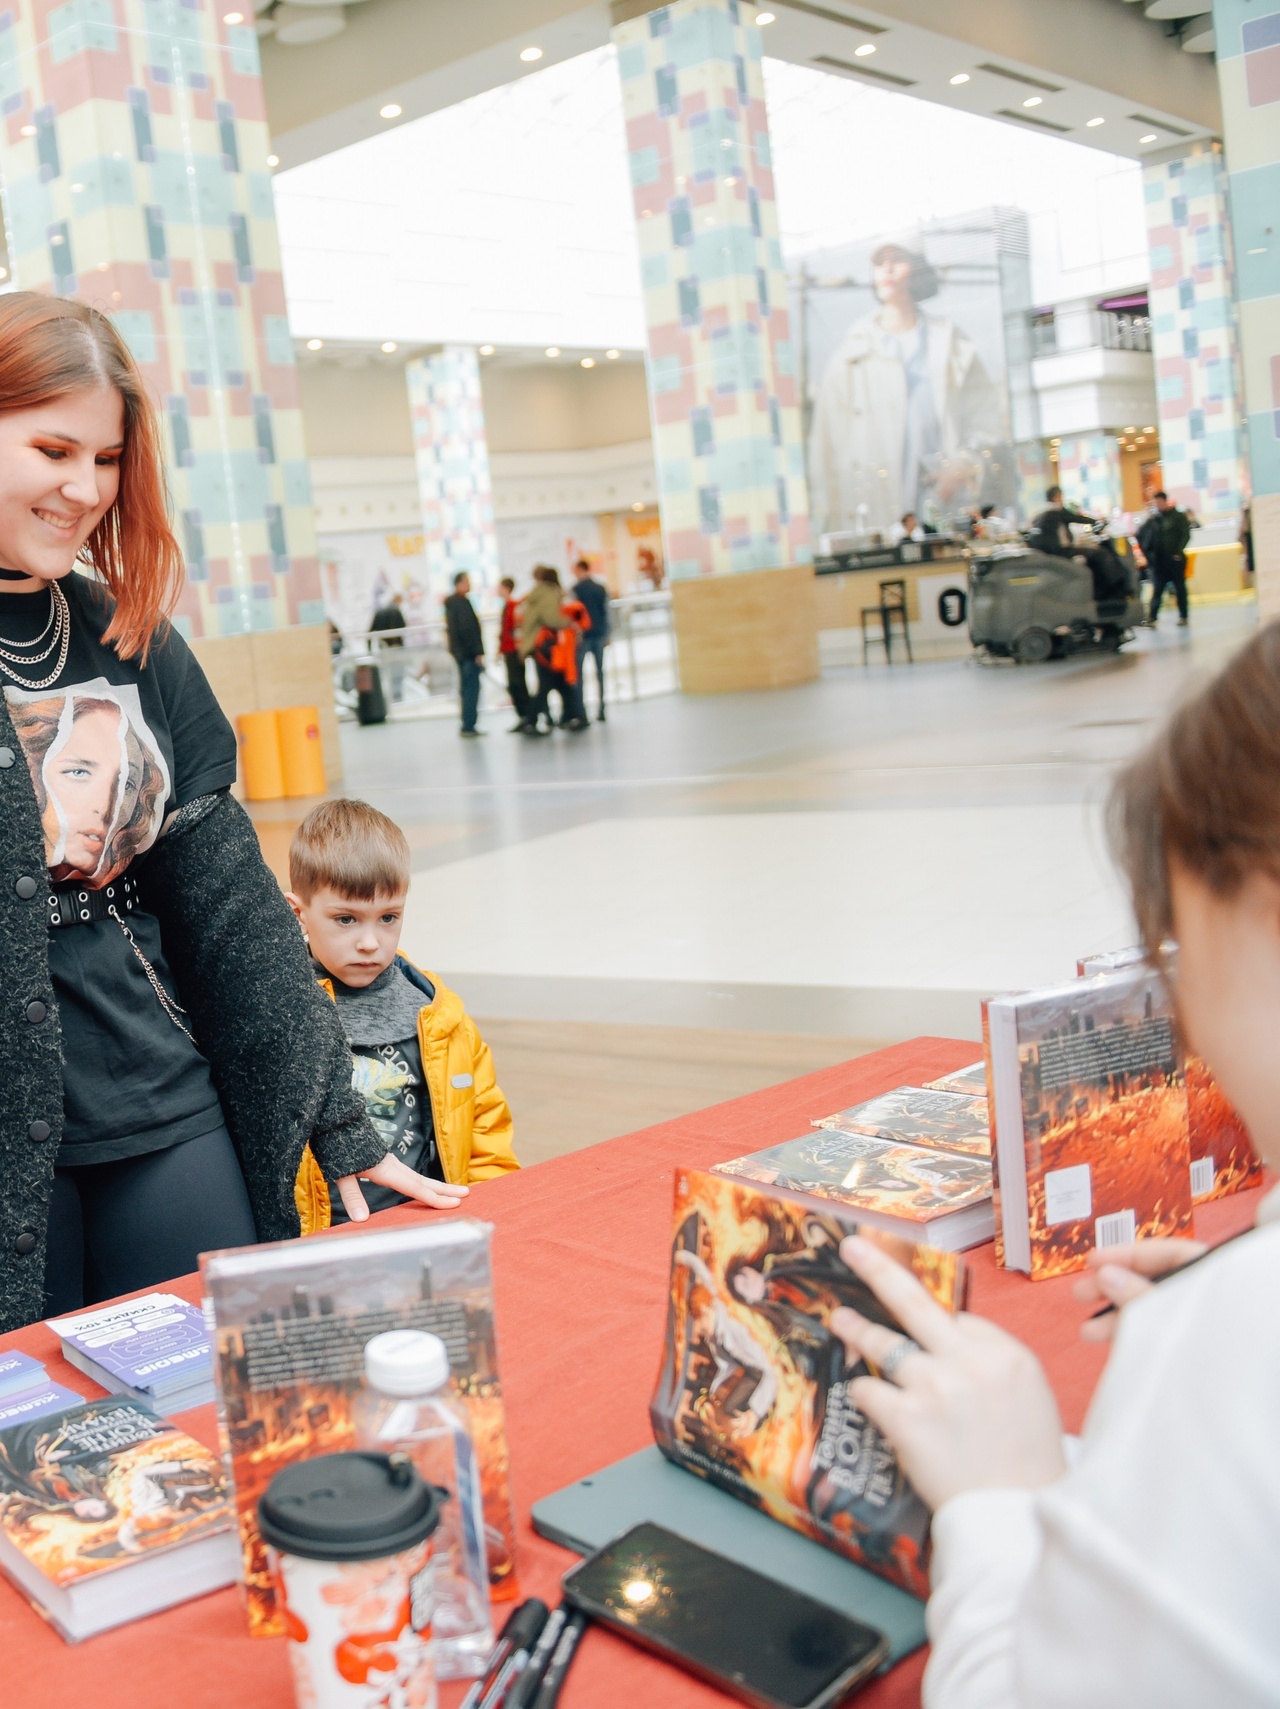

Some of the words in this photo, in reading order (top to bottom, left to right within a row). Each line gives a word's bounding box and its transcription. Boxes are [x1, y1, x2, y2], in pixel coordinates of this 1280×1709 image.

[397, 1129, 414, 1155] WE
[74, 1320, 101, 1332] 10%
[103, 1305, 156, 1323] СКИДКА
[58, 1405, 138, 1437] ПЕЧАЛИ
[79, 1424, 136, 1451] ОГНЕ
